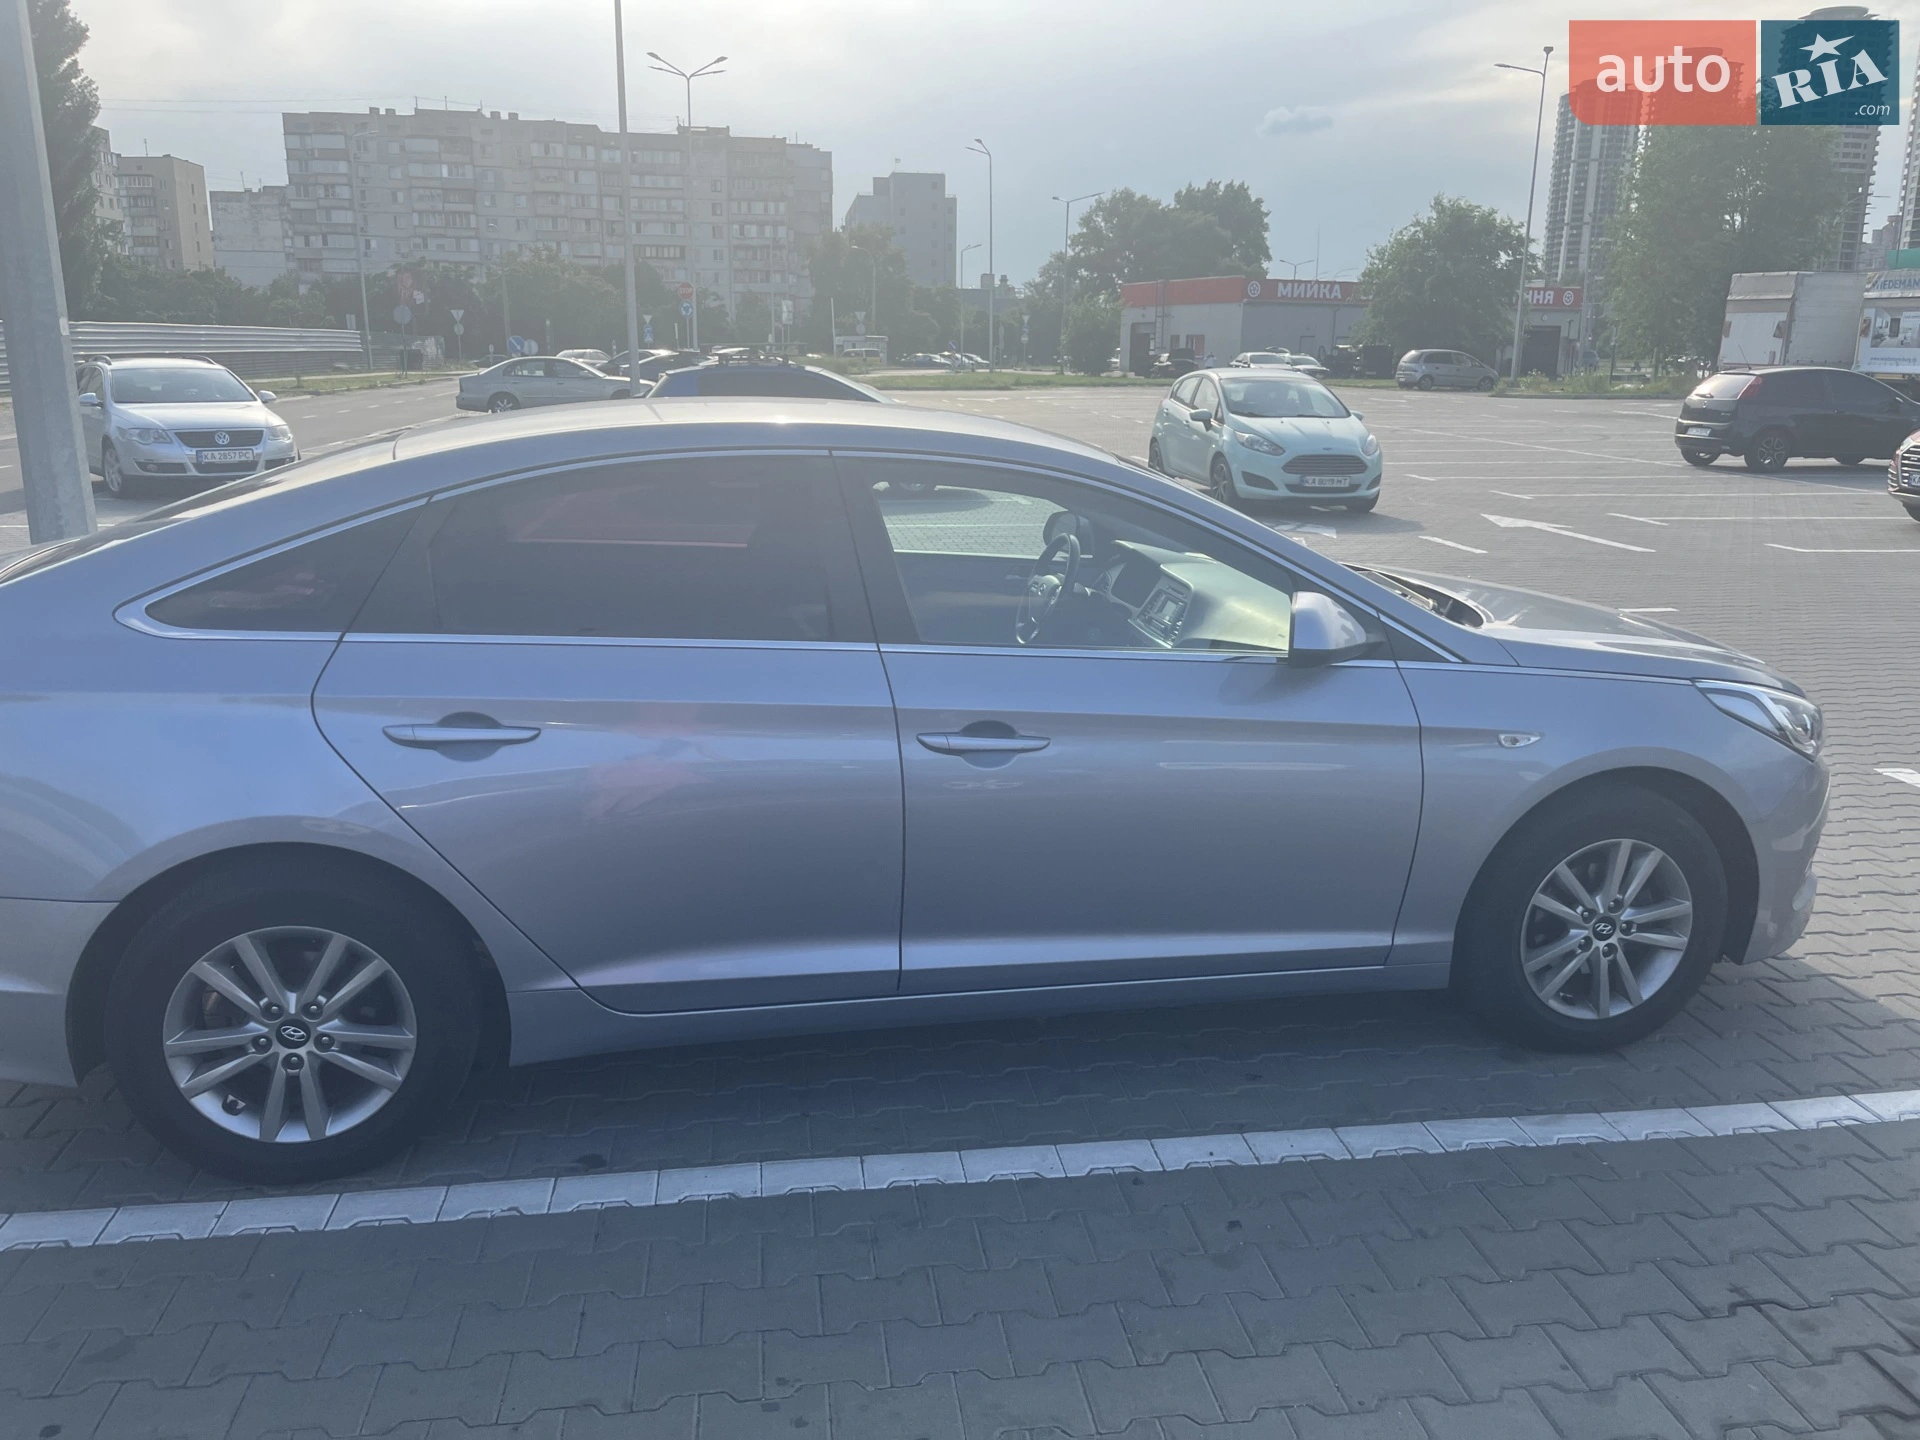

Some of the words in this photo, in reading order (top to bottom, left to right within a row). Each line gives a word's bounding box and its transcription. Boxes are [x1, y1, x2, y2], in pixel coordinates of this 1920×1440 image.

[1277, 281, 1342, 299] МИЙКА
[203, 452, 216, 460] KA
[218, 452, 237, 460] 2857
[238, 451, 250, 460] PC
[1304, 478, 1315, 486] KA
